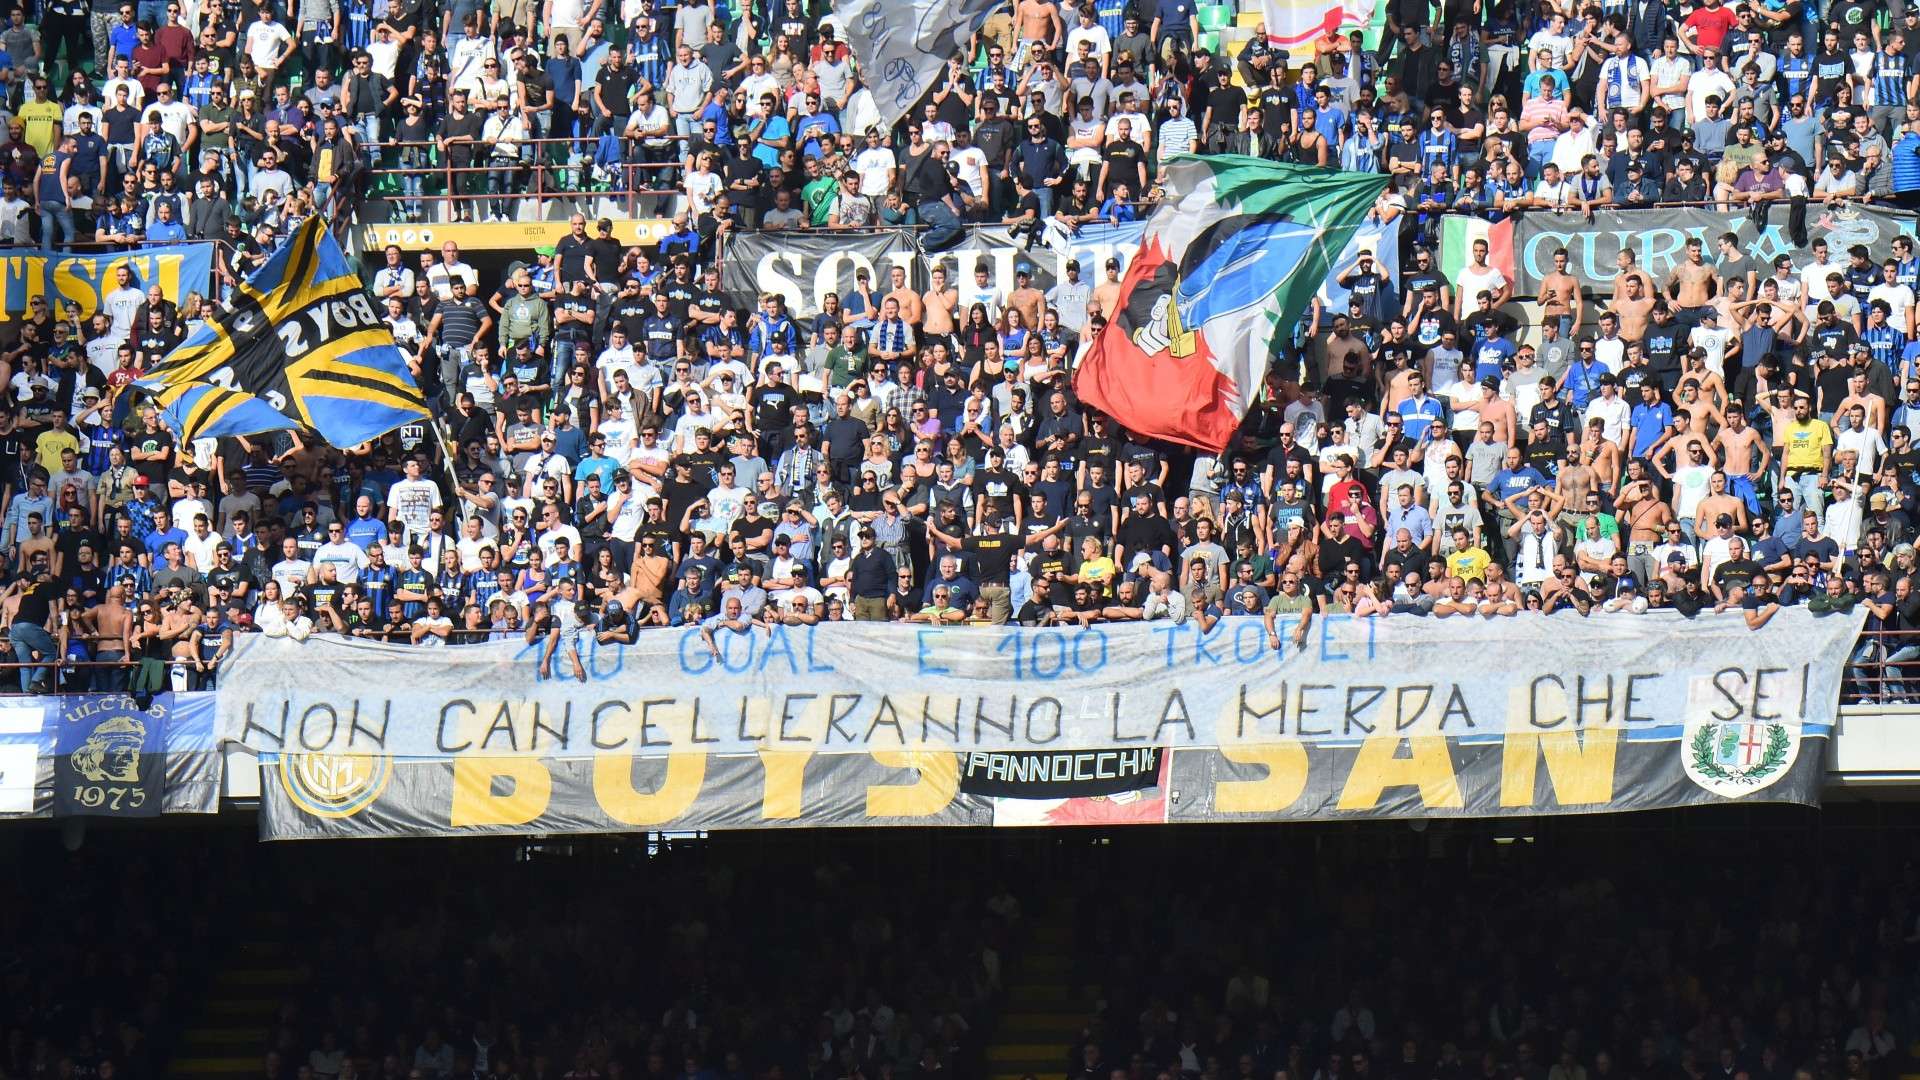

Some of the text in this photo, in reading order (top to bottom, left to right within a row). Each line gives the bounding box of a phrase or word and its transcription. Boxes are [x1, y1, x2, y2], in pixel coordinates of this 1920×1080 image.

[524, 226, 546, 236] USCITA
[1523, 215, 1801, 282] CURVA
[1508, 476, 1531, 487] NIKE
[679, 625, 834, 676] GOAL
[917, 629, 951, 677] E
[997, 628, 1107, 680] 100
[65, 695, 168, 723] ULTRS
[241, 699, 392, 752] NON
[437, 694, 1062, 753] CANCELLERANNO
[1113, 687, 1195, 742] LA
[1237, 680, 1475, 738] MERDA
[1530, 672, 1663, 729] CHE
[1711, 662, 1810, 722] SEI
[1214, 708, 1618, 813] SAN
[73, 785, 146, 811] 1975
